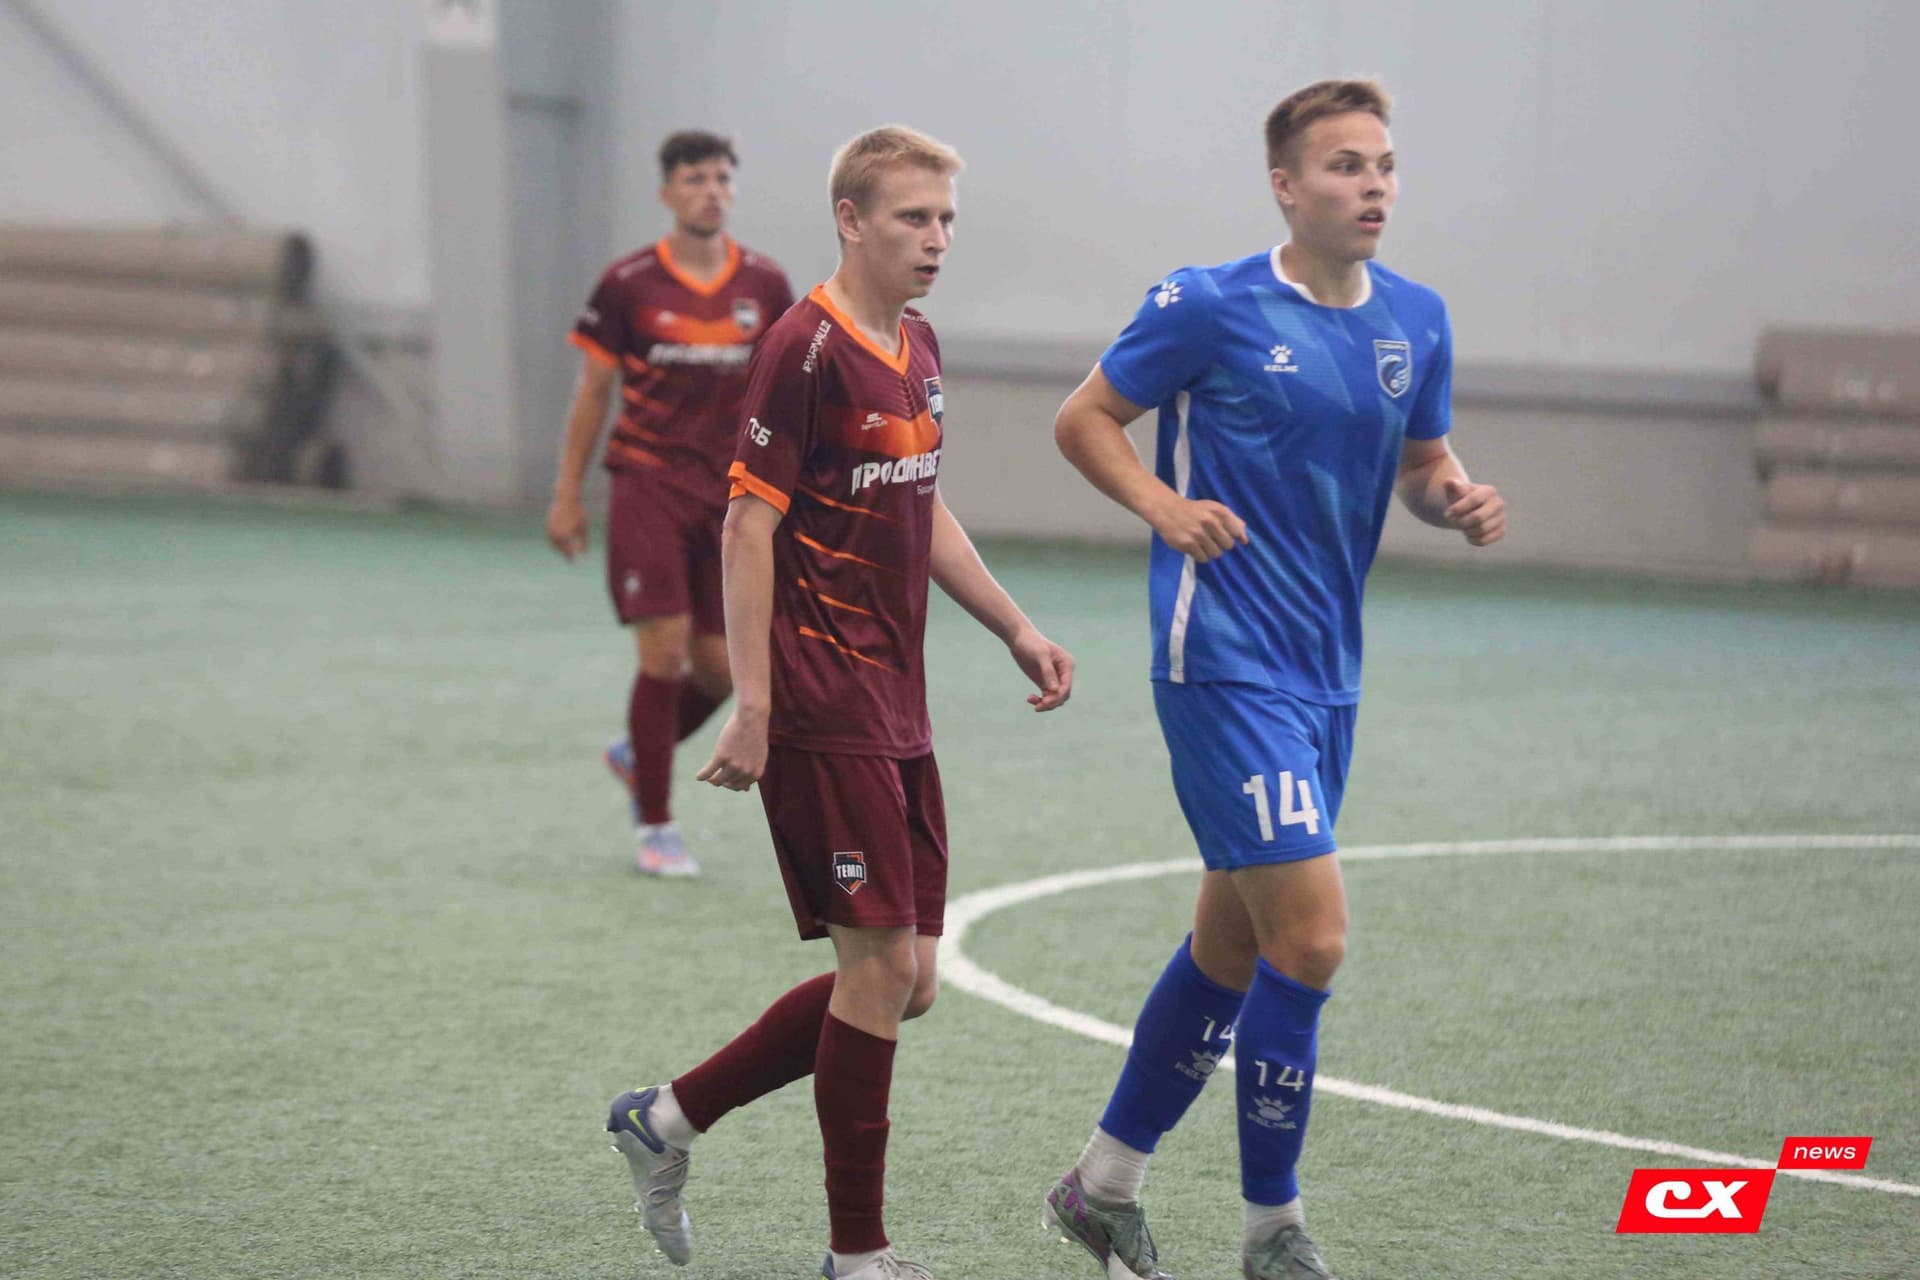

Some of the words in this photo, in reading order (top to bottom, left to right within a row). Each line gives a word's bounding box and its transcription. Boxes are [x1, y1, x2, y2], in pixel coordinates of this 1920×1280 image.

[1242, 771, 1320, 842] 14
[835, 864, 864, 879] ТЕМП
[1254, 1060, 1306, 1092] 14
